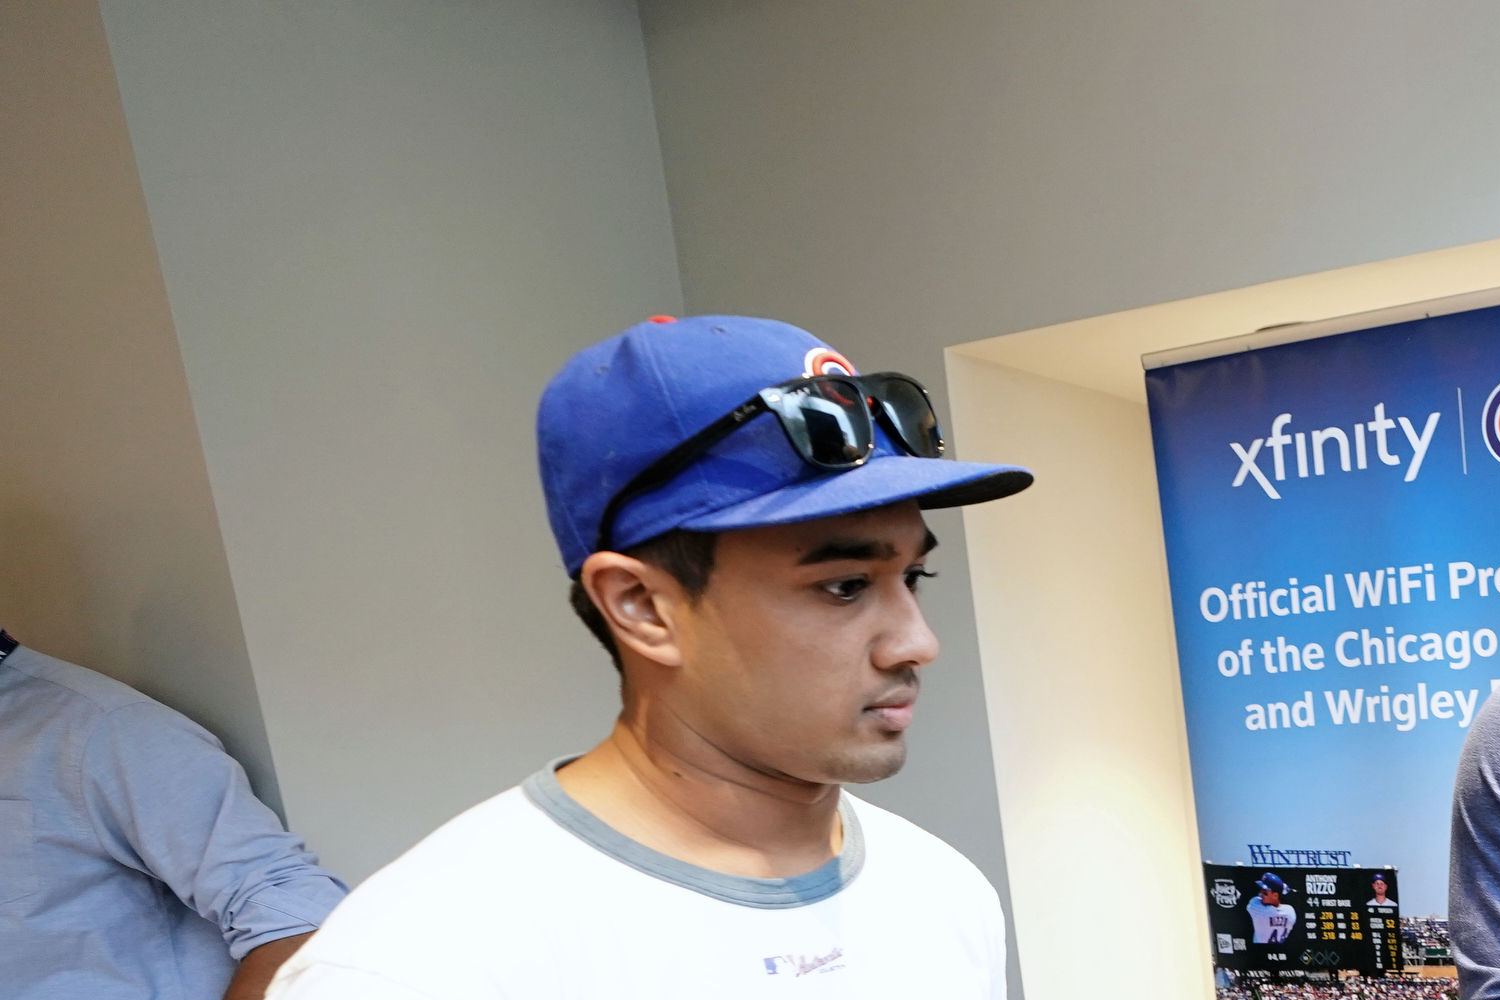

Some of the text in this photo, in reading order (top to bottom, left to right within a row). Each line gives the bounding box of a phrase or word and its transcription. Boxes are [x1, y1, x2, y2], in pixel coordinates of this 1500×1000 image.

[1229, 402, 1442, 500] xfinity
[1199, 573, 1336, 623] Official
[1344, 563, 1436, 609] WiFi
[1217, 639, 1254, 678] of
[1260, 636, 1325, 674] the
[1334, 626, 1499, 670] Chicago
[1244, 682, 1479, 732] and Wrigley
[1248, 843, 1352, 867] WINTRUST
[1305, 882, 1337, 895] RIZZO
